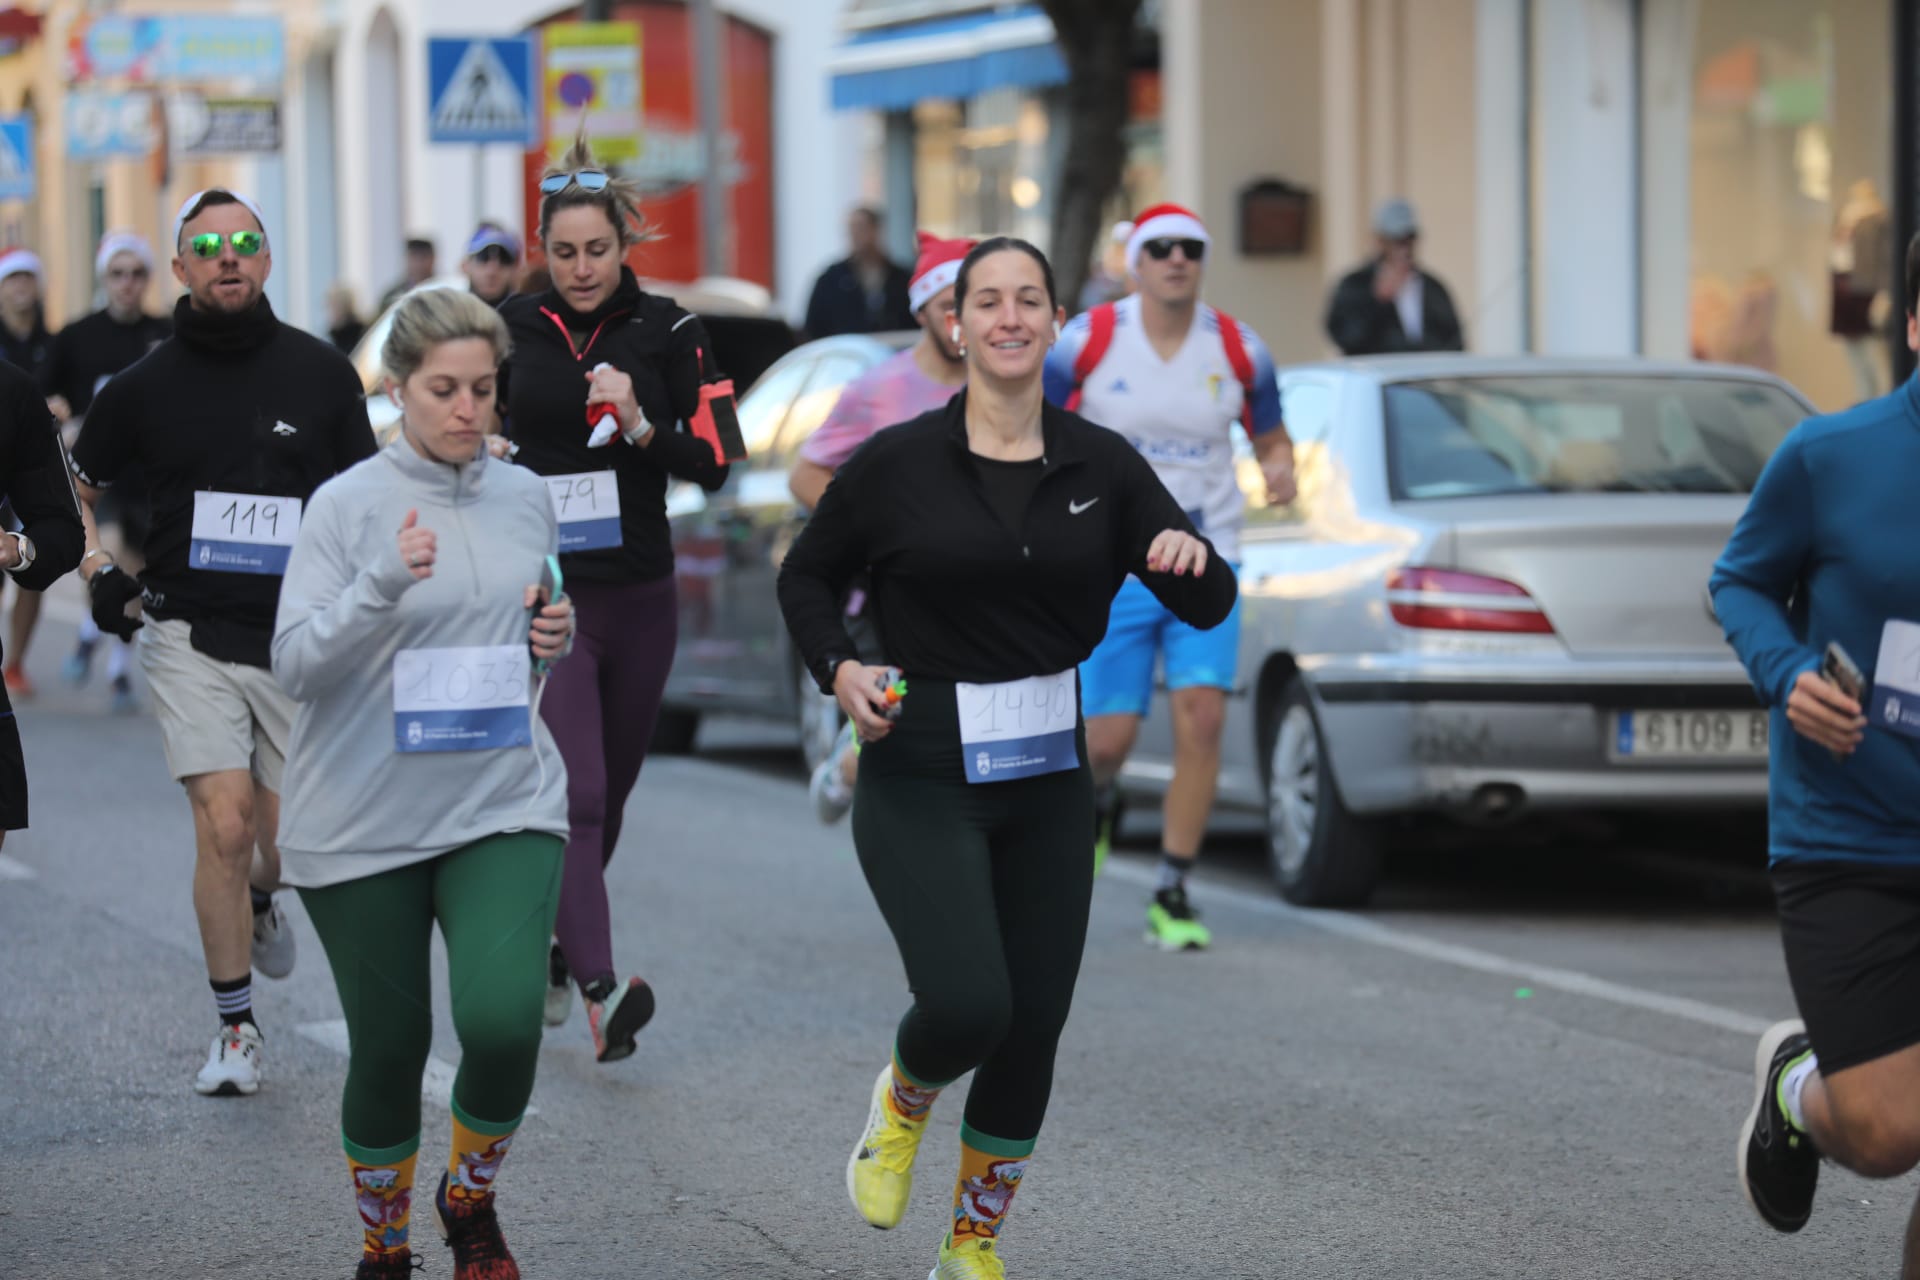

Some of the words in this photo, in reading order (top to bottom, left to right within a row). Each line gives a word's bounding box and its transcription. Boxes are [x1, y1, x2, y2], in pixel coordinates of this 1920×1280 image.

[545, 477, 597, 515] 79
[221, 499, 279, 537] 119
[404, 659, 524, 704] 1033
[974, 683, 1066, 734] 1440
[1645, 711, 1734, 752] 6109
